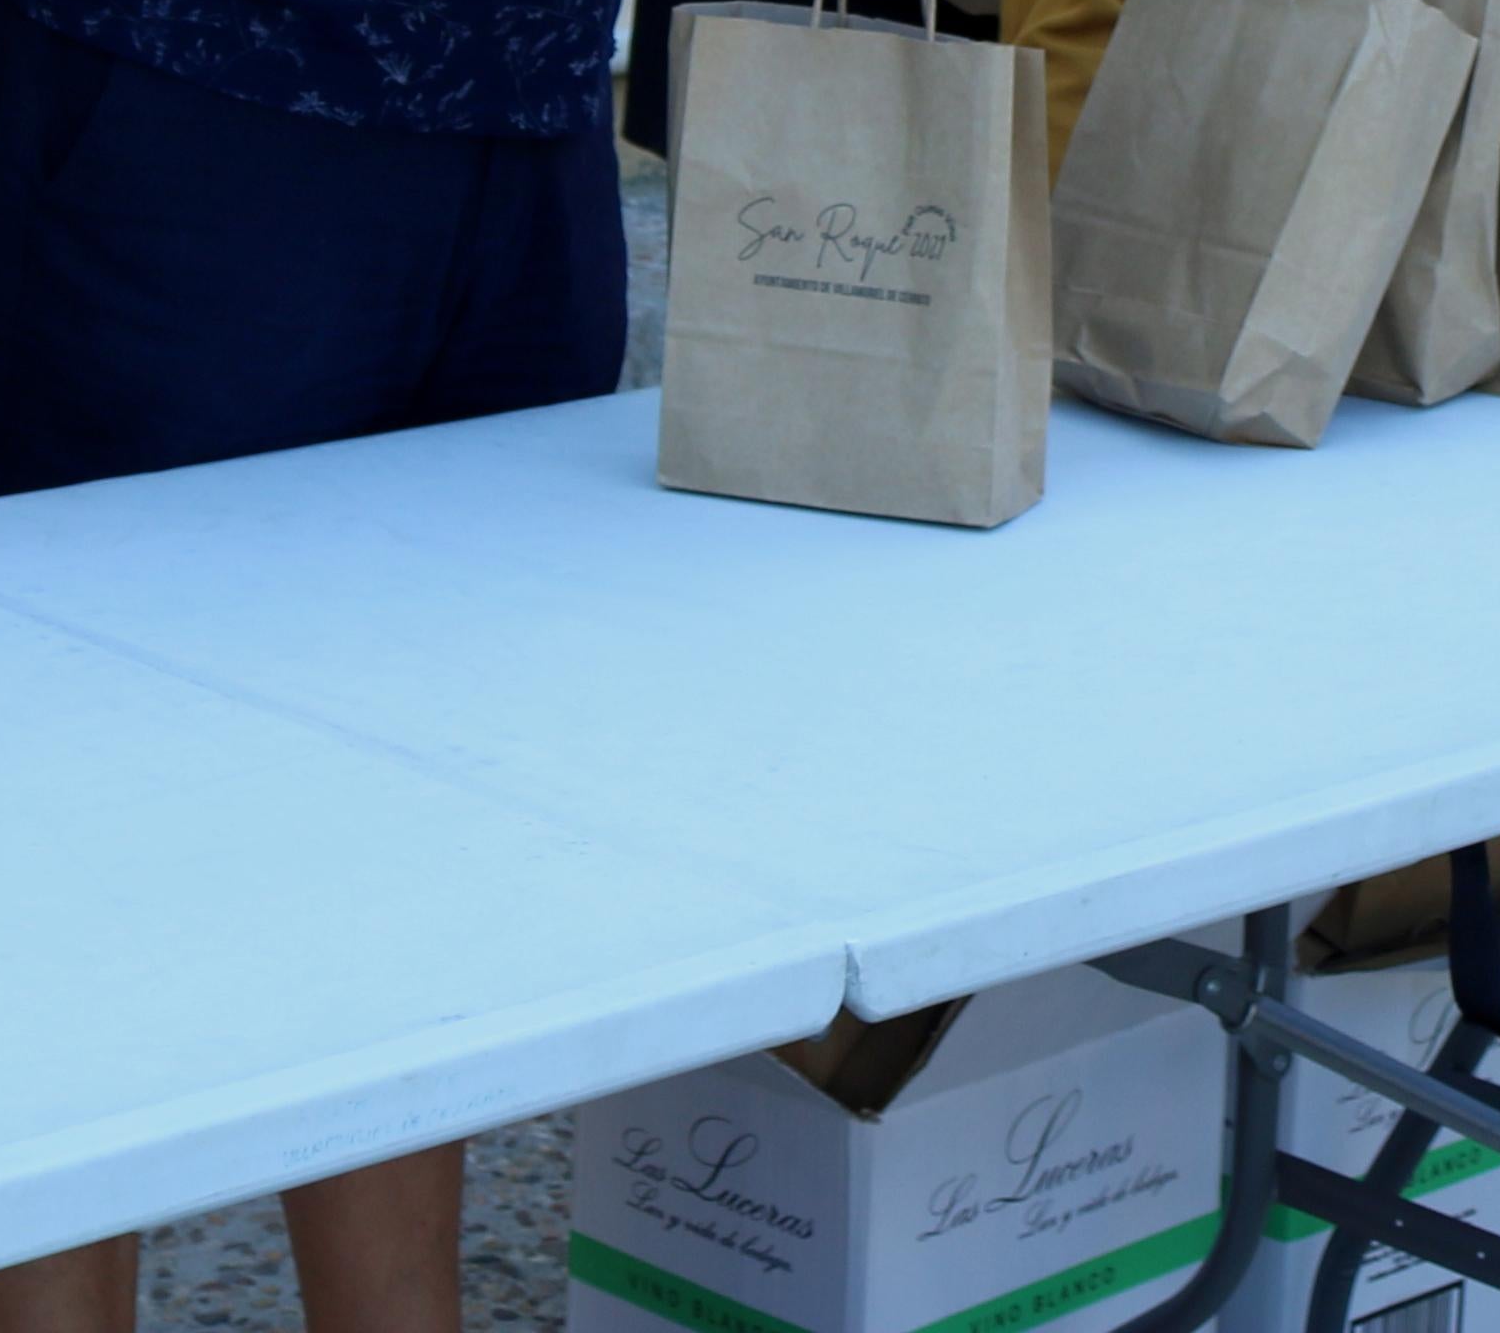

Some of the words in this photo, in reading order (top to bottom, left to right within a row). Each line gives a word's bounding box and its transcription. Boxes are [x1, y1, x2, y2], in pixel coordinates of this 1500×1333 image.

[737, 195, 803, 262] San
[816, 202, 902, 282] Roque
[611, 1126, 668, 1182] Las
[669, 1115, 815, 1240] Luceras
[915, 1172, 982, 1243] Las
[983, 1087, 1136, 1214] Luceras
[628, 1272, 681, 1310] VINO
[969, 1303, 1023, 1333] VINO
[1032, 1265, 1117, 1315] BLANCO
